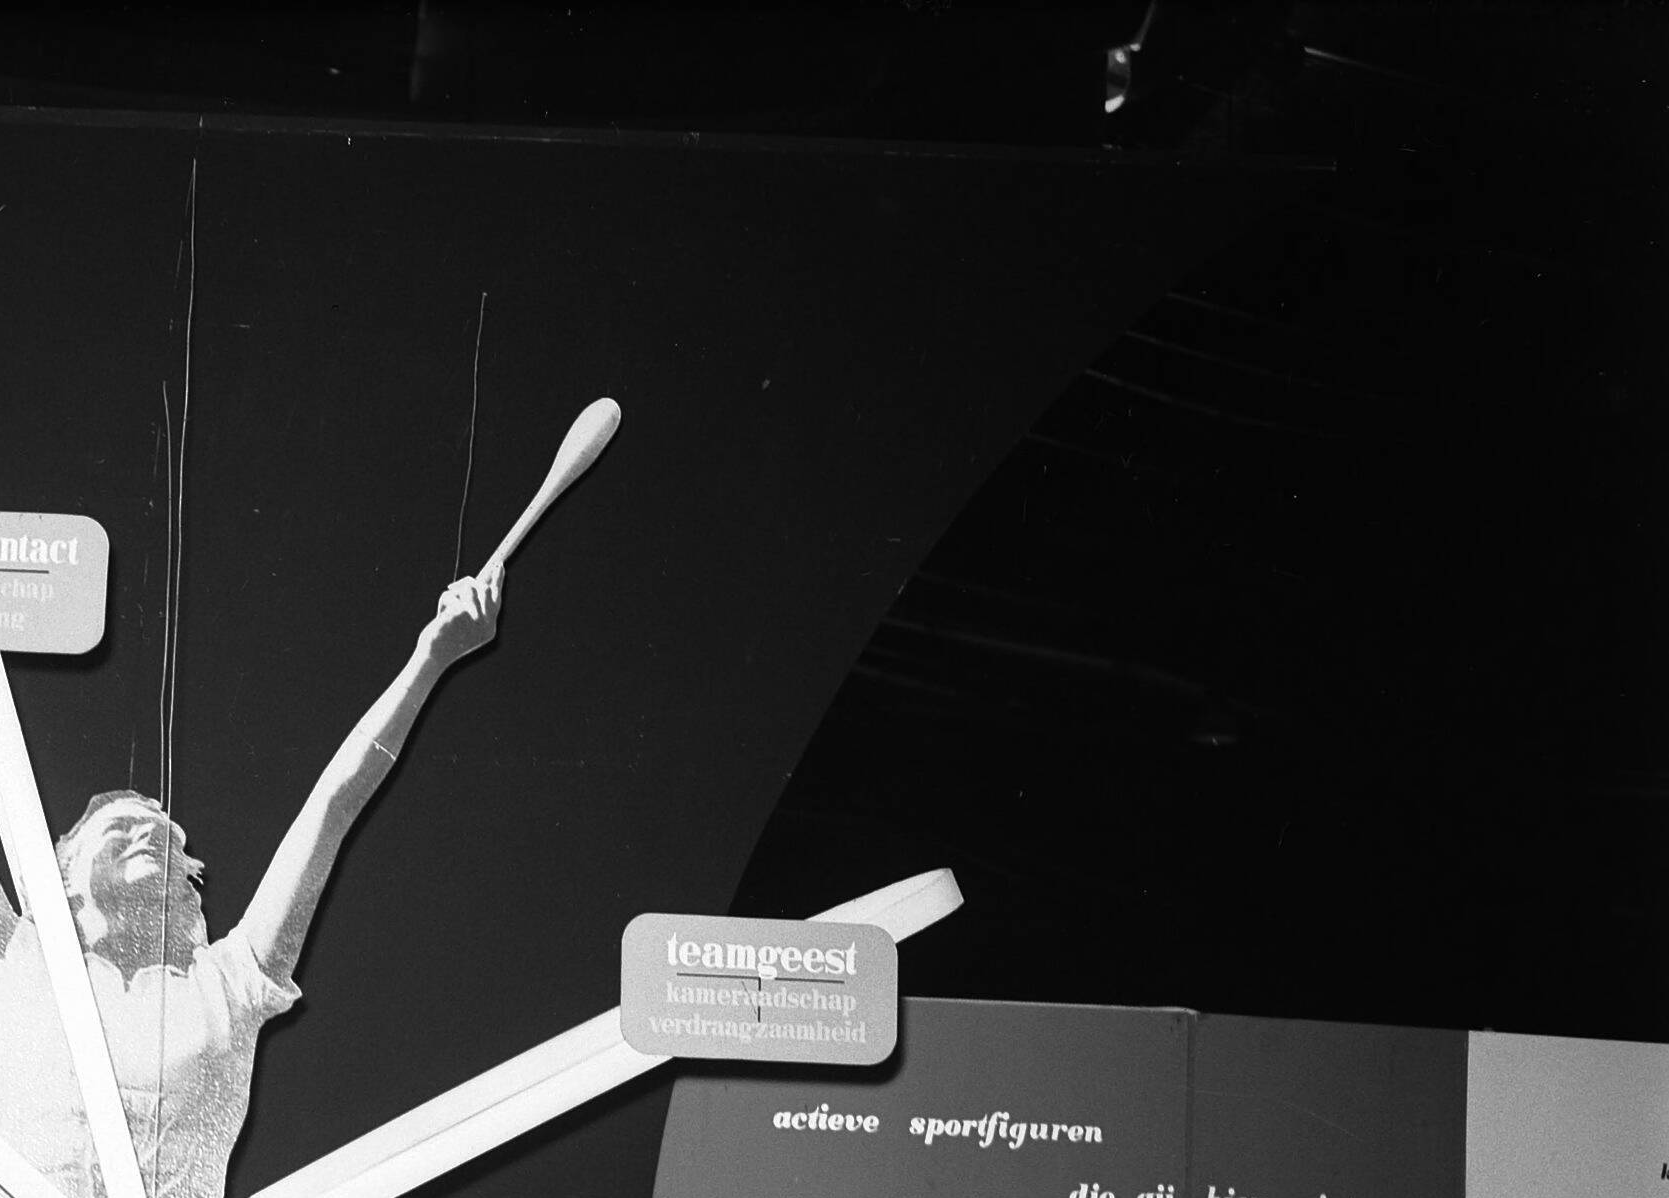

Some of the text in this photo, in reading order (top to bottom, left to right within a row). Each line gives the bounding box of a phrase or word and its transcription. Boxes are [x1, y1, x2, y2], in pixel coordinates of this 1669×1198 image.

[667, 931, 858, 980] teamgeest
[665, 981, 857, 1017] kameraadschap
[648, 1014, 867, 1044] verdraagzaamheid
[772, 1104, 1103, 1149] actieve sportfiguren
